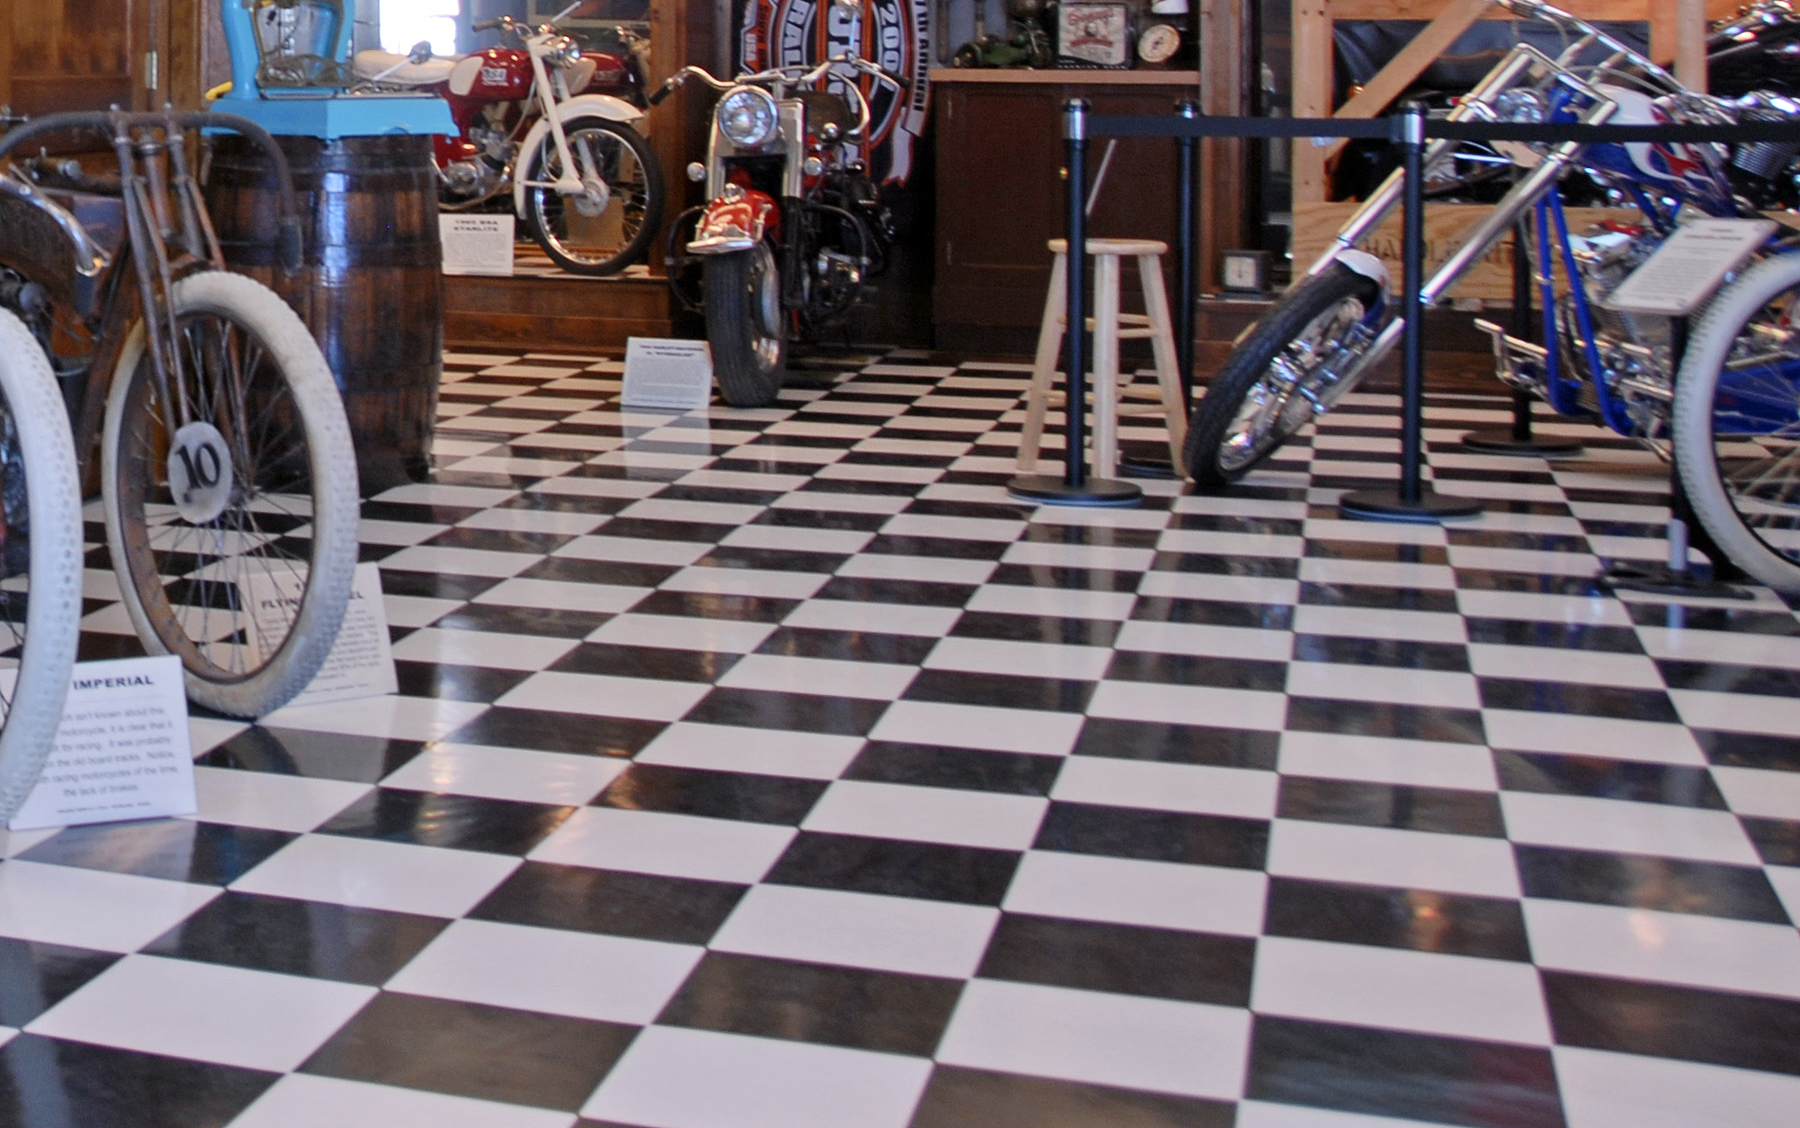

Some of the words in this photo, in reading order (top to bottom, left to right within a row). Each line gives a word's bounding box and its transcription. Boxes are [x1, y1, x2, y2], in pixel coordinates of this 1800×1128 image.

[745, 33, 757, 63] USA
[880, 3, 901, 88] 200
[912, 38, 929, 112] Annual
[175, 441, 221, 489] 10
[261, 598, 300, 610] FLYIN
[73, 675, 154, 690] IMPERIAL
